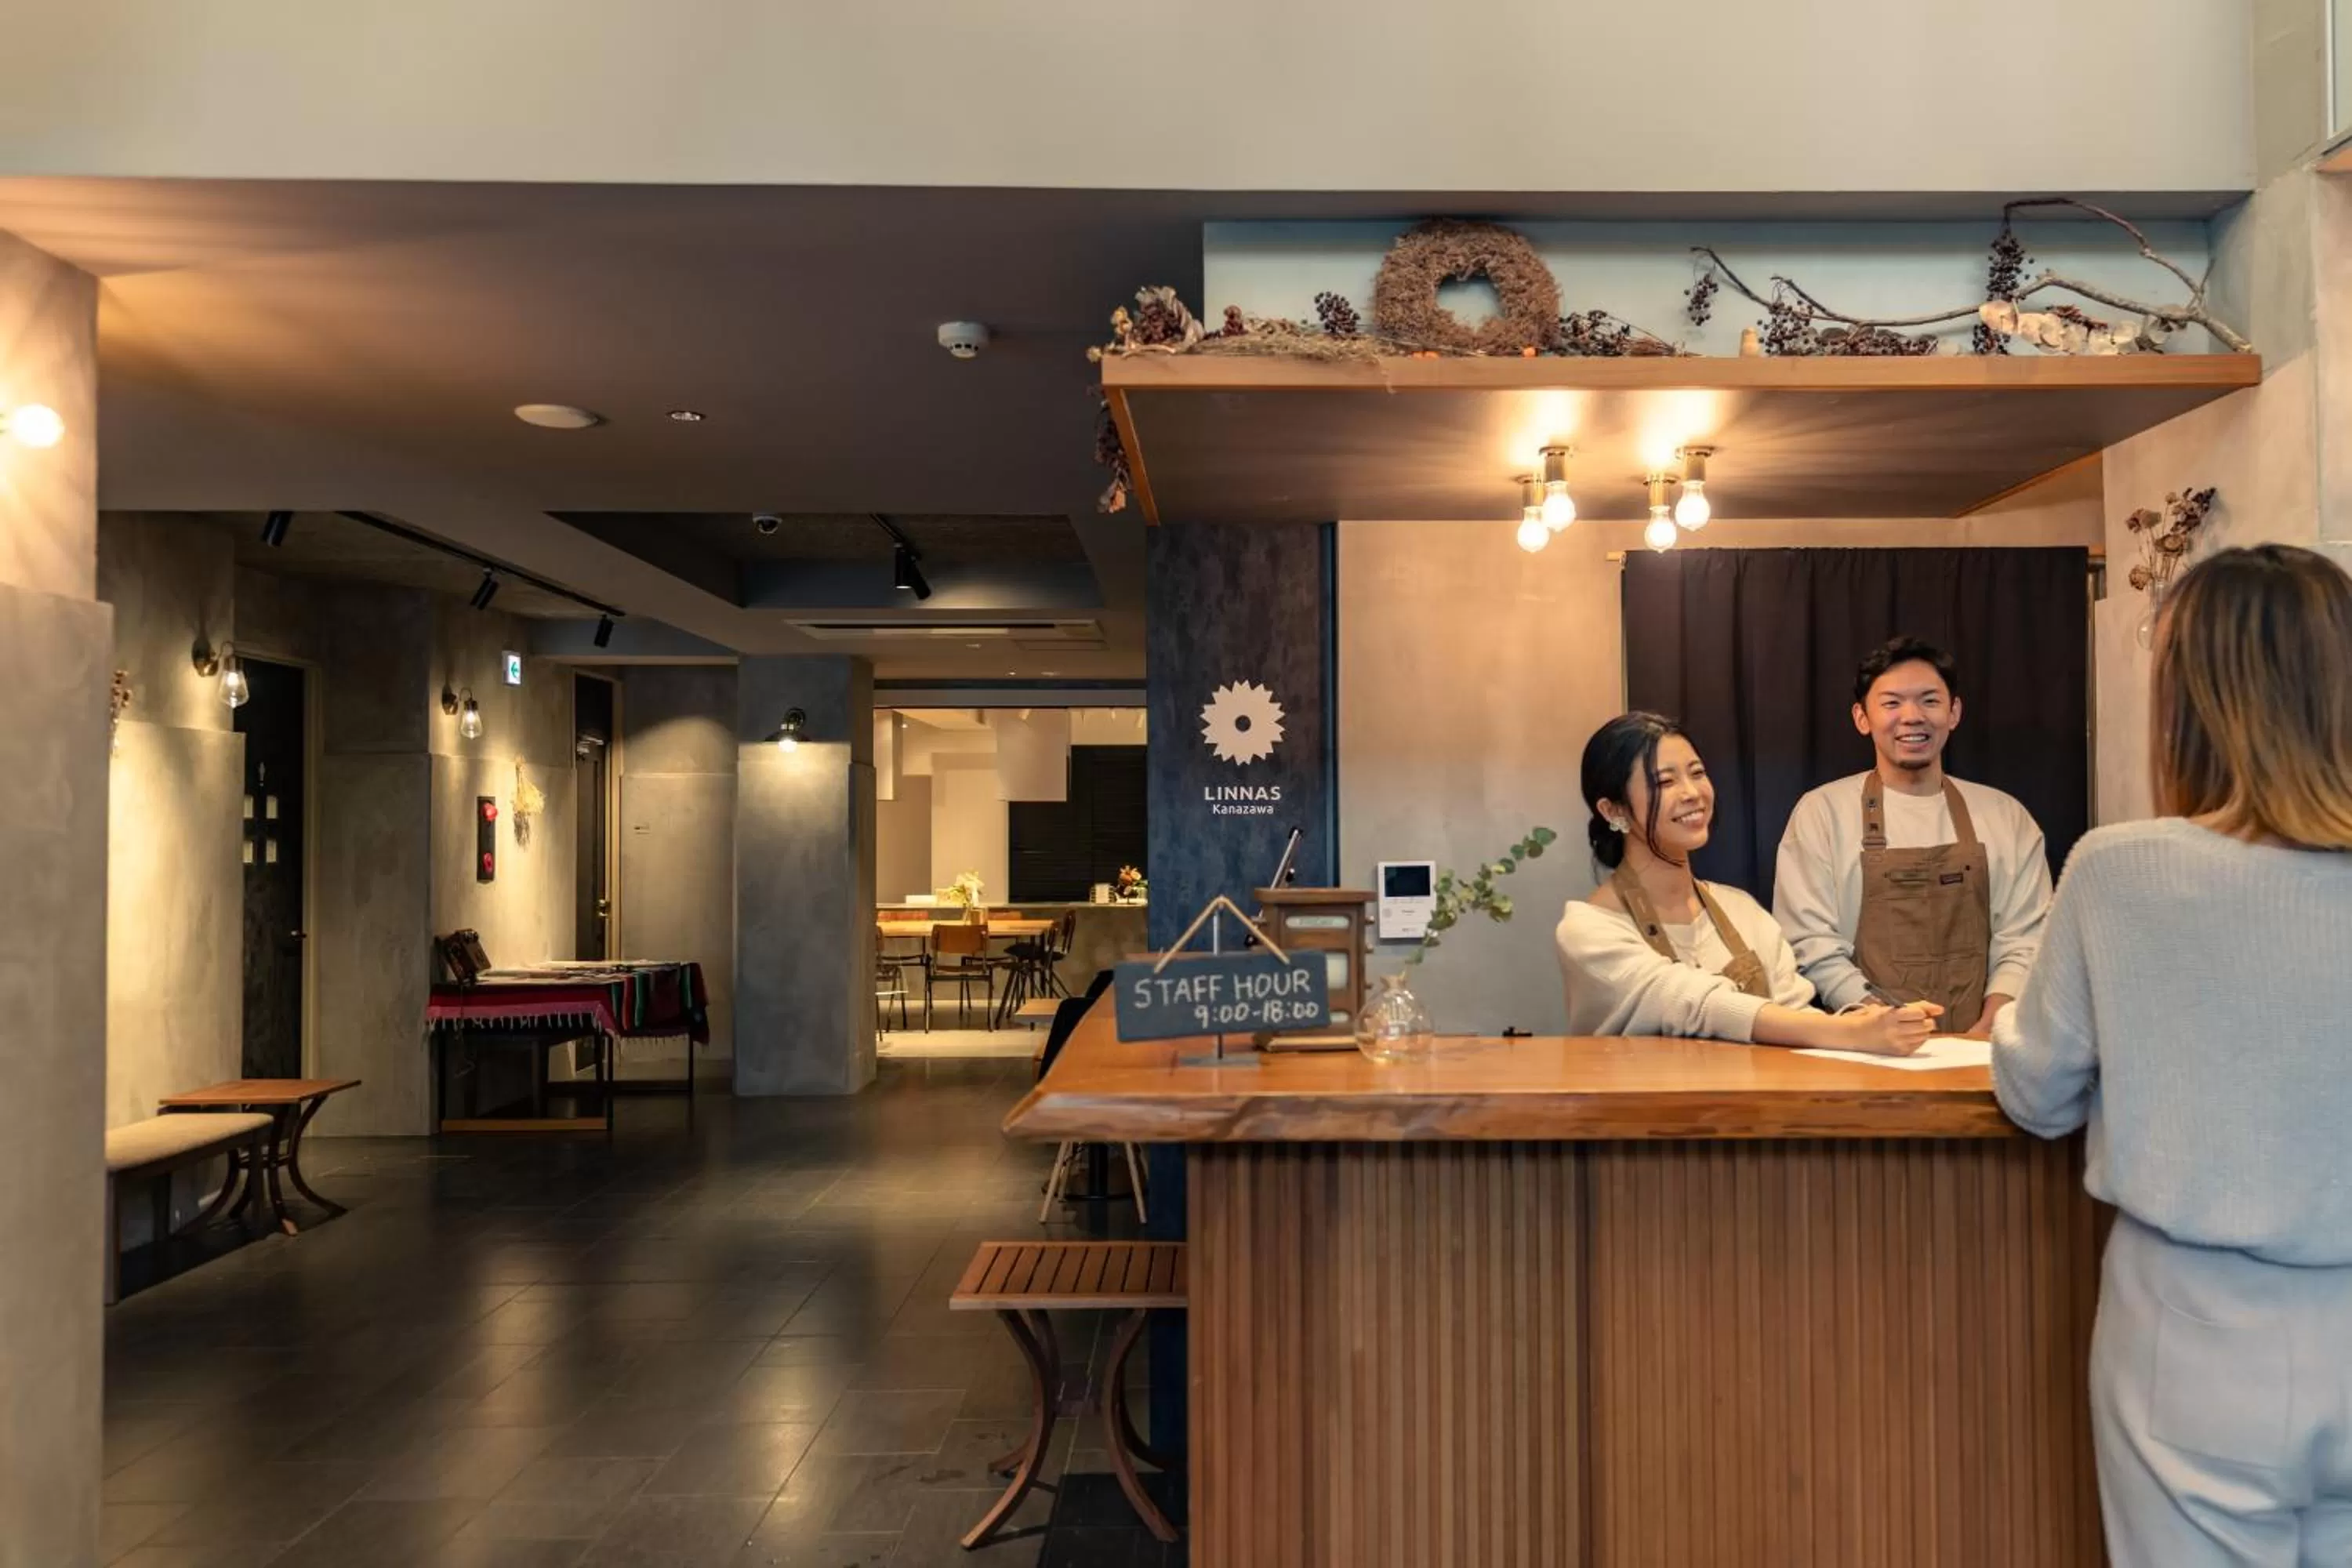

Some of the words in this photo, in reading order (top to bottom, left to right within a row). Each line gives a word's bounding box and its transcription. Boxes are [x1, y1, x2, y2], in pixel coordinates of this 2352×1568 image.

[1204, 786, 1282, 800] LINNAS
[1213, 804, 1274, 815] Kanazawa
[1134, 975, 1224, 1009] STAFF
[1233, 969, 1312, 1000] HOUR
[1195, 1000, 1319, 1029] 9:00-18:00
